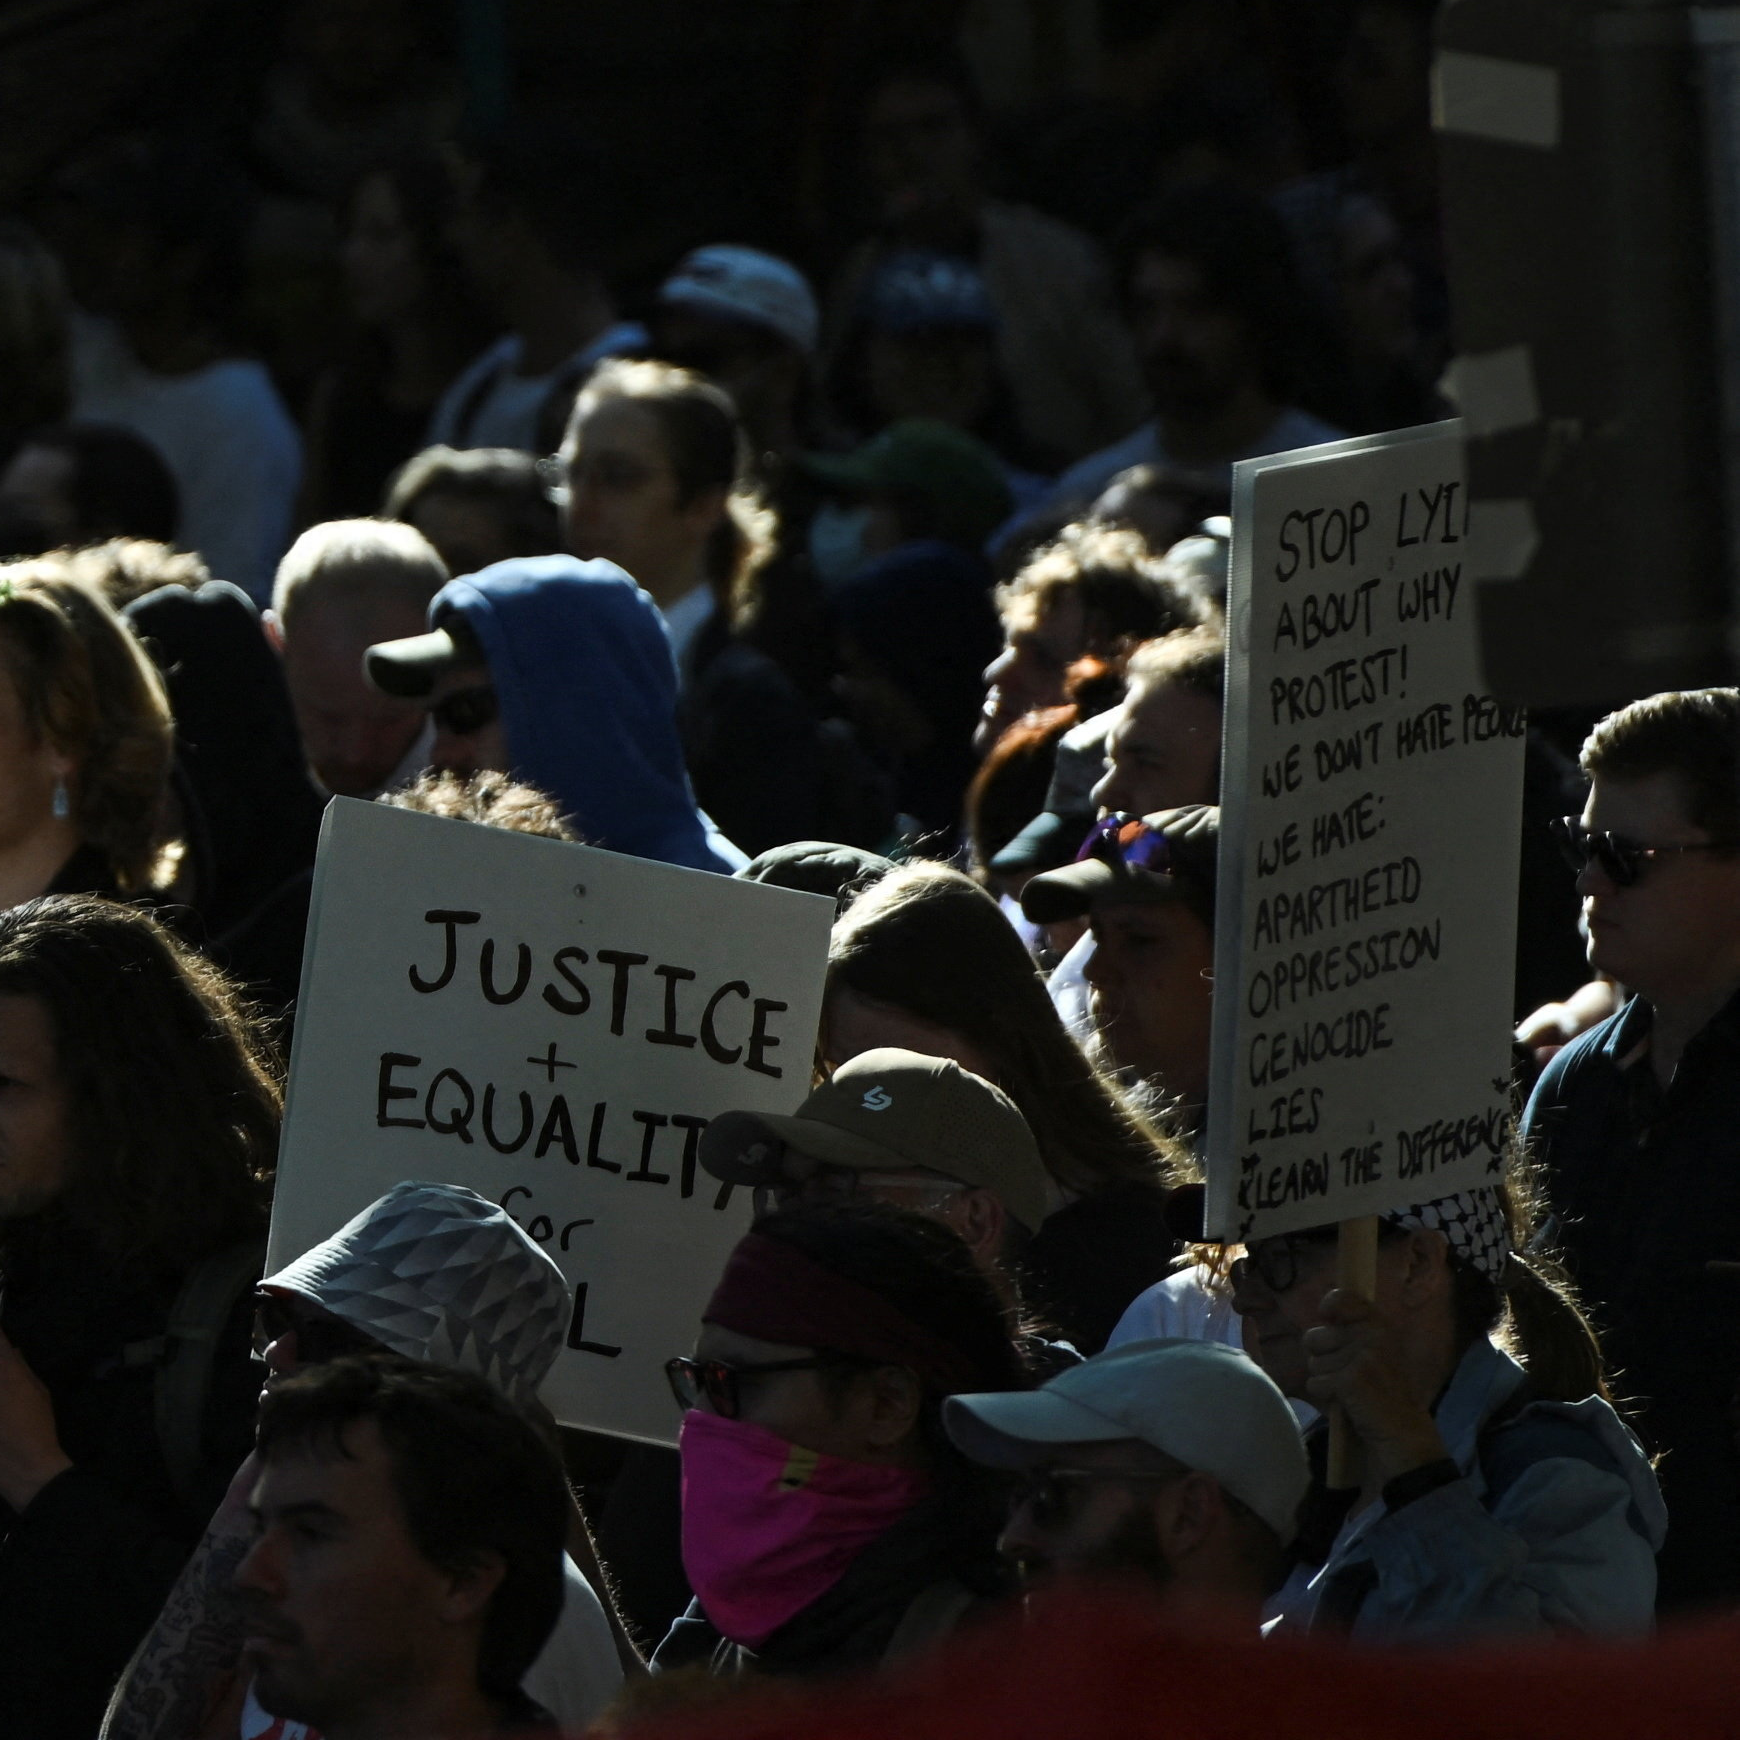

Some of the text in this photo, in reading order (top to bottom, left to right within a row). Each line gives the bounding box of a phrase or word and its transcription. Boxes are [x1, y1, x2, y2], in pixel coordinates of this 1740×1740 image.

[1275, 500, 1370, 583] STOP
[1274, 563, 1462, 653] ABOUT WHY
[1269, 644, 1409, 725] PROTEST!
[1262, 744, 1303, 798] WE
[1397, 703, 1455, 760] HATE
[1257, 792, 1386, 879] WE HATE:
[1253, 855, 1422, 951] APARTHEID
[408, 909, 789, 1078] JUSTICE
[1248, 918, 1442, 1019] OPPRESSION
[1248, 1003, 1393, 1087] GENOCIDE
[1248, 1087, 1324, 1145] LIES
[1255, 1106, 1512, 1210] LEARN THE DIFFERENCE
